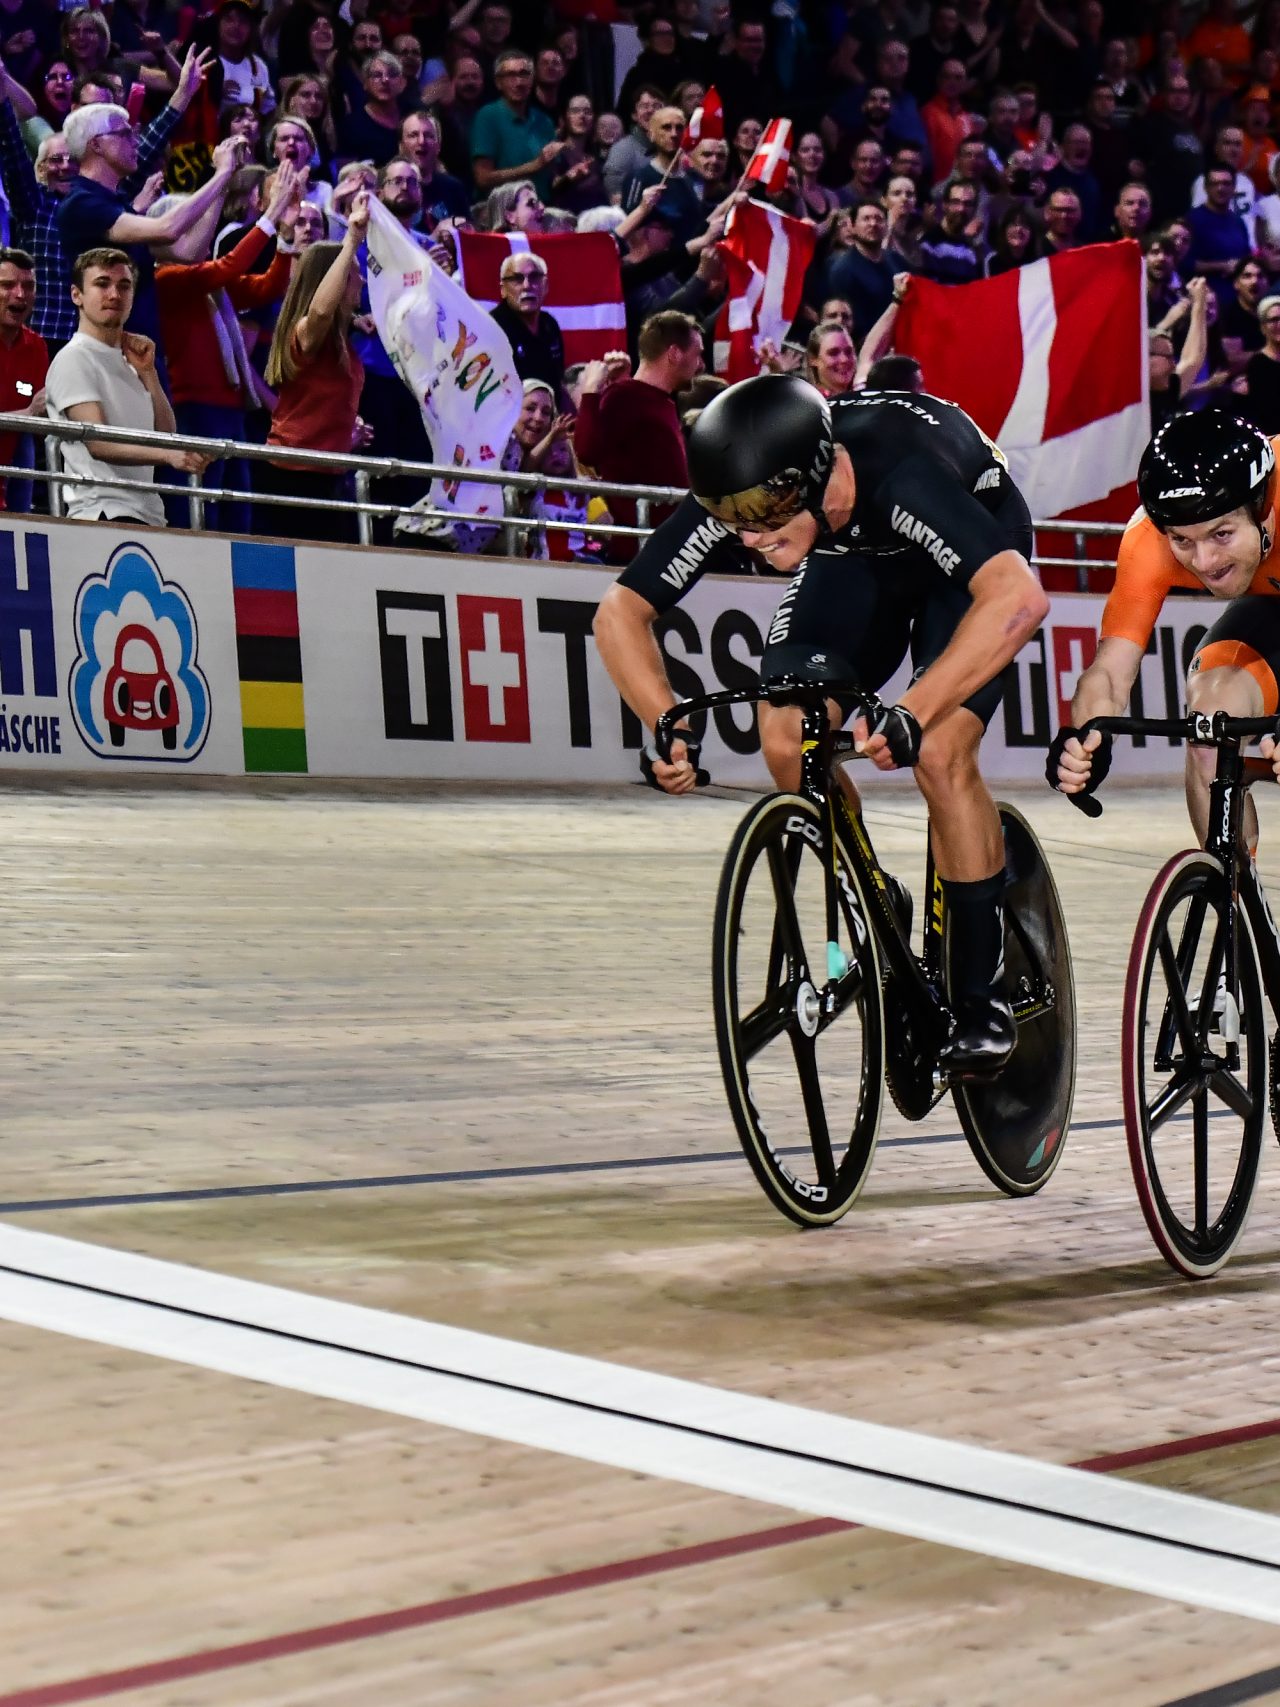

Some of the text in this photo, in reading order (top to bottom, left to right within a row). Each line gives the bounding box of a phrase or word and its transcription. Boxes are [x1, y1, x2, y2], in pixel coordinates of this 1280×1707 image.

[890, 400, 941, 425] NEW
[660, 515, 730, 591] VANTAG
[890, 505, 962, 577] VANTAGE
[1222, 787, 1232, 843] KOGA
